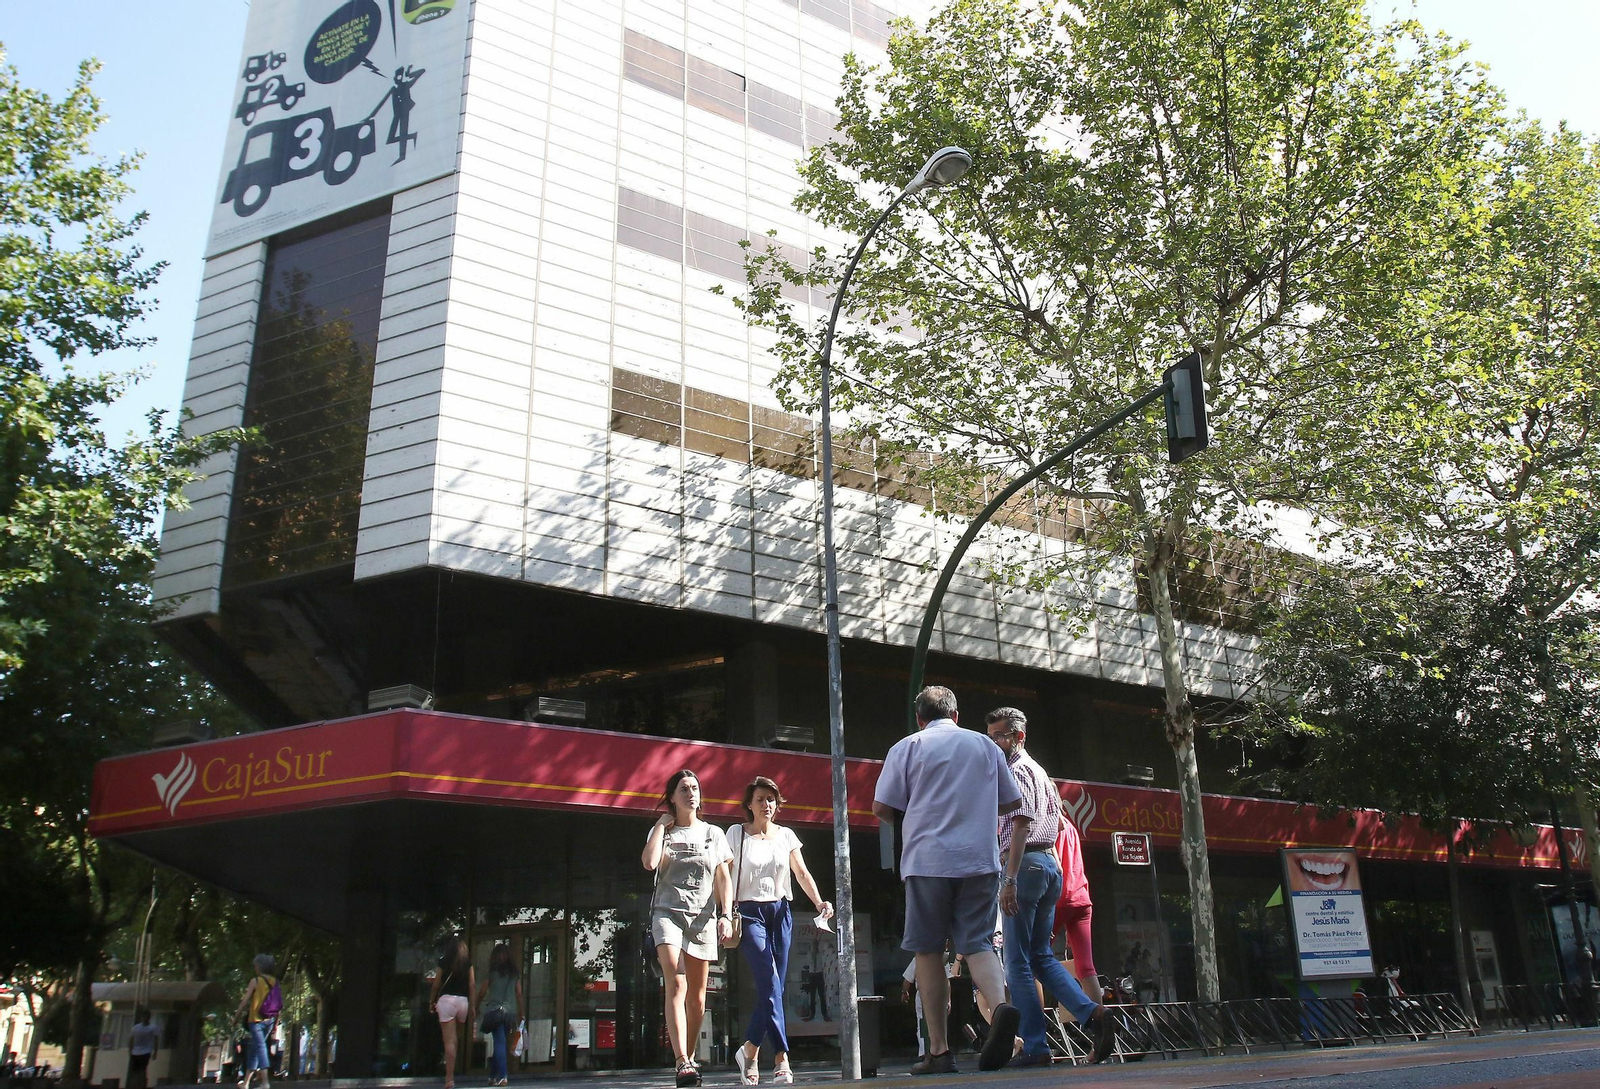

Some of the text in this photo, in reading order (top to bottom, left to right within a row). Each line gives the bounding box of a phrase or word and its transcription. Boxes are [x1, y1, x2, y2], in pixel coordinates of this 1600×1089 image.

[317, 35, 340, 48] BANCA
[341, 22, 365, 38] ONLINE
[350, 17, 360, 27] EN
[264, 53, 272, 68] 1
[313, 50, 337, 63] BANCA
[358, 35, 368, 44] DE
[321, 45, 331, 54] EN
[331, 41, 341, 49] LA
[262, 77, 280, 103] 2
[288, 117, 325, 171] 3
[202, 746, 332, 800] CajaSur
[1102, 799, 1183, 832] CajaSu
[1311, 916, 1350, 926] Jesús María
